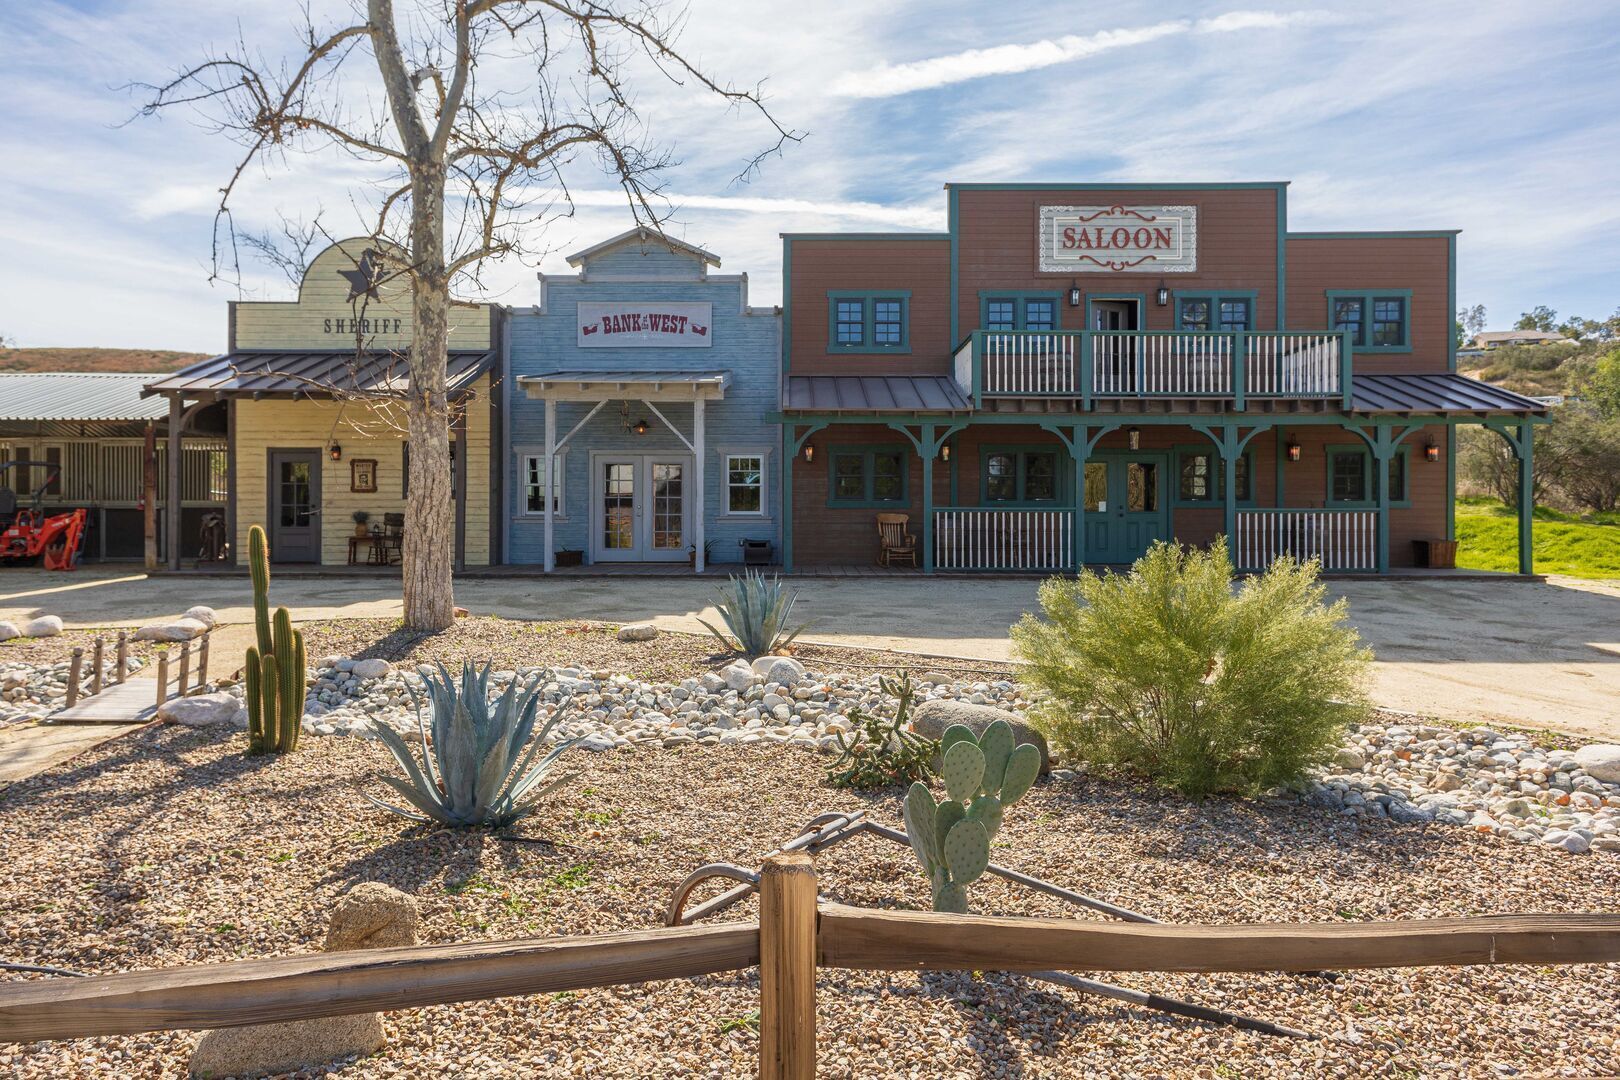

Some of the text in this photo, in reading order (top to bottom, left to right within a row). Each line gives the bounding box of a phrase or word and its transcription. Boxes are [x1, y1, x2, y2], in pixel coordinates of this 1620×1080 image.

[1062, 227, 1173, 249] SALOON
[324, 318, 402, 334] SHERIFF
[602, 313, 642, 334] BANK
[649, 313, 688, 334] WEST
